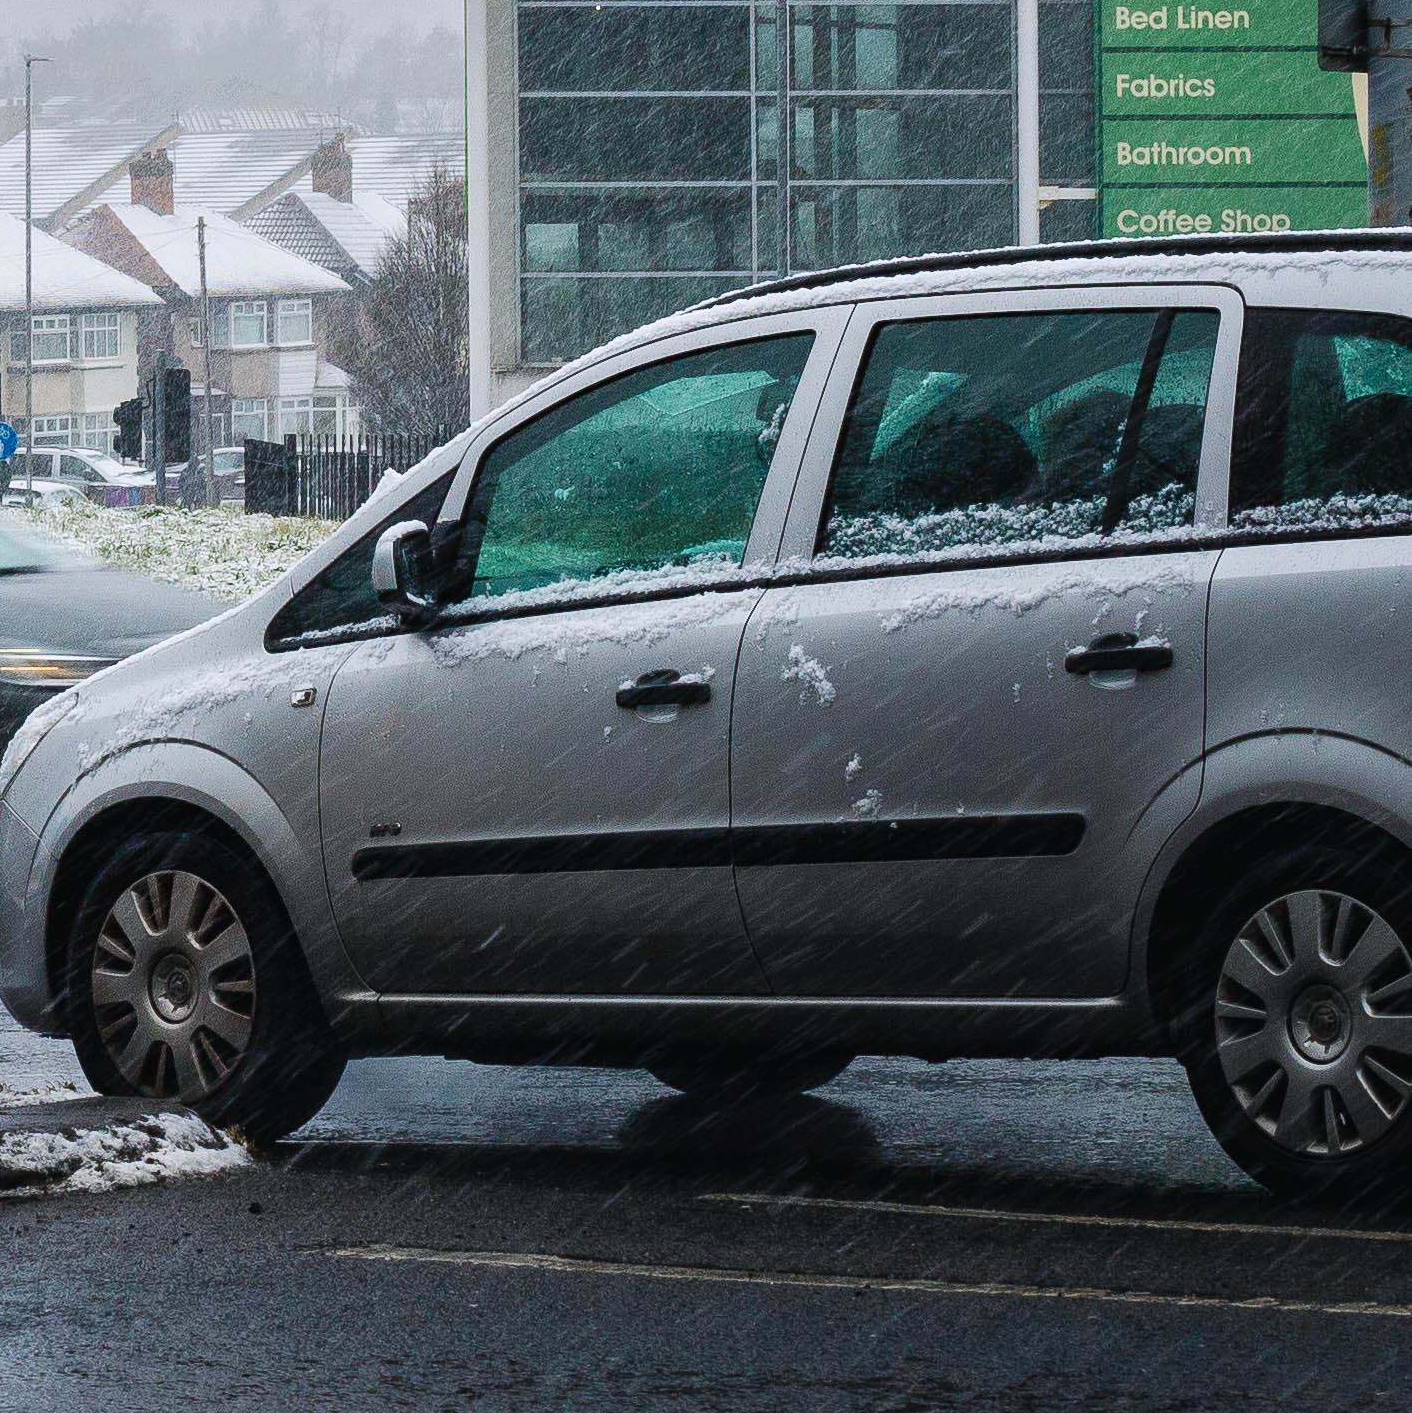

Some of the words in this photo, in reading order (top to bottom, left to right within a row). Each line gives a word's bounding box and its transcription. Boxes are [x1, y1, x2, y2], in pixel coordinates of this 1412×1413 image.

[1115, 6, 1168, 30] Bed
[1177, 5, 1250, 29] Linen
[1116, 73, 1216, 98] Fabrics
[1117, 142, 1253, 166] Bathroom
[1116, 209, 1213, 233] Coffee
[1220, 209, 1291, 233] Shop
